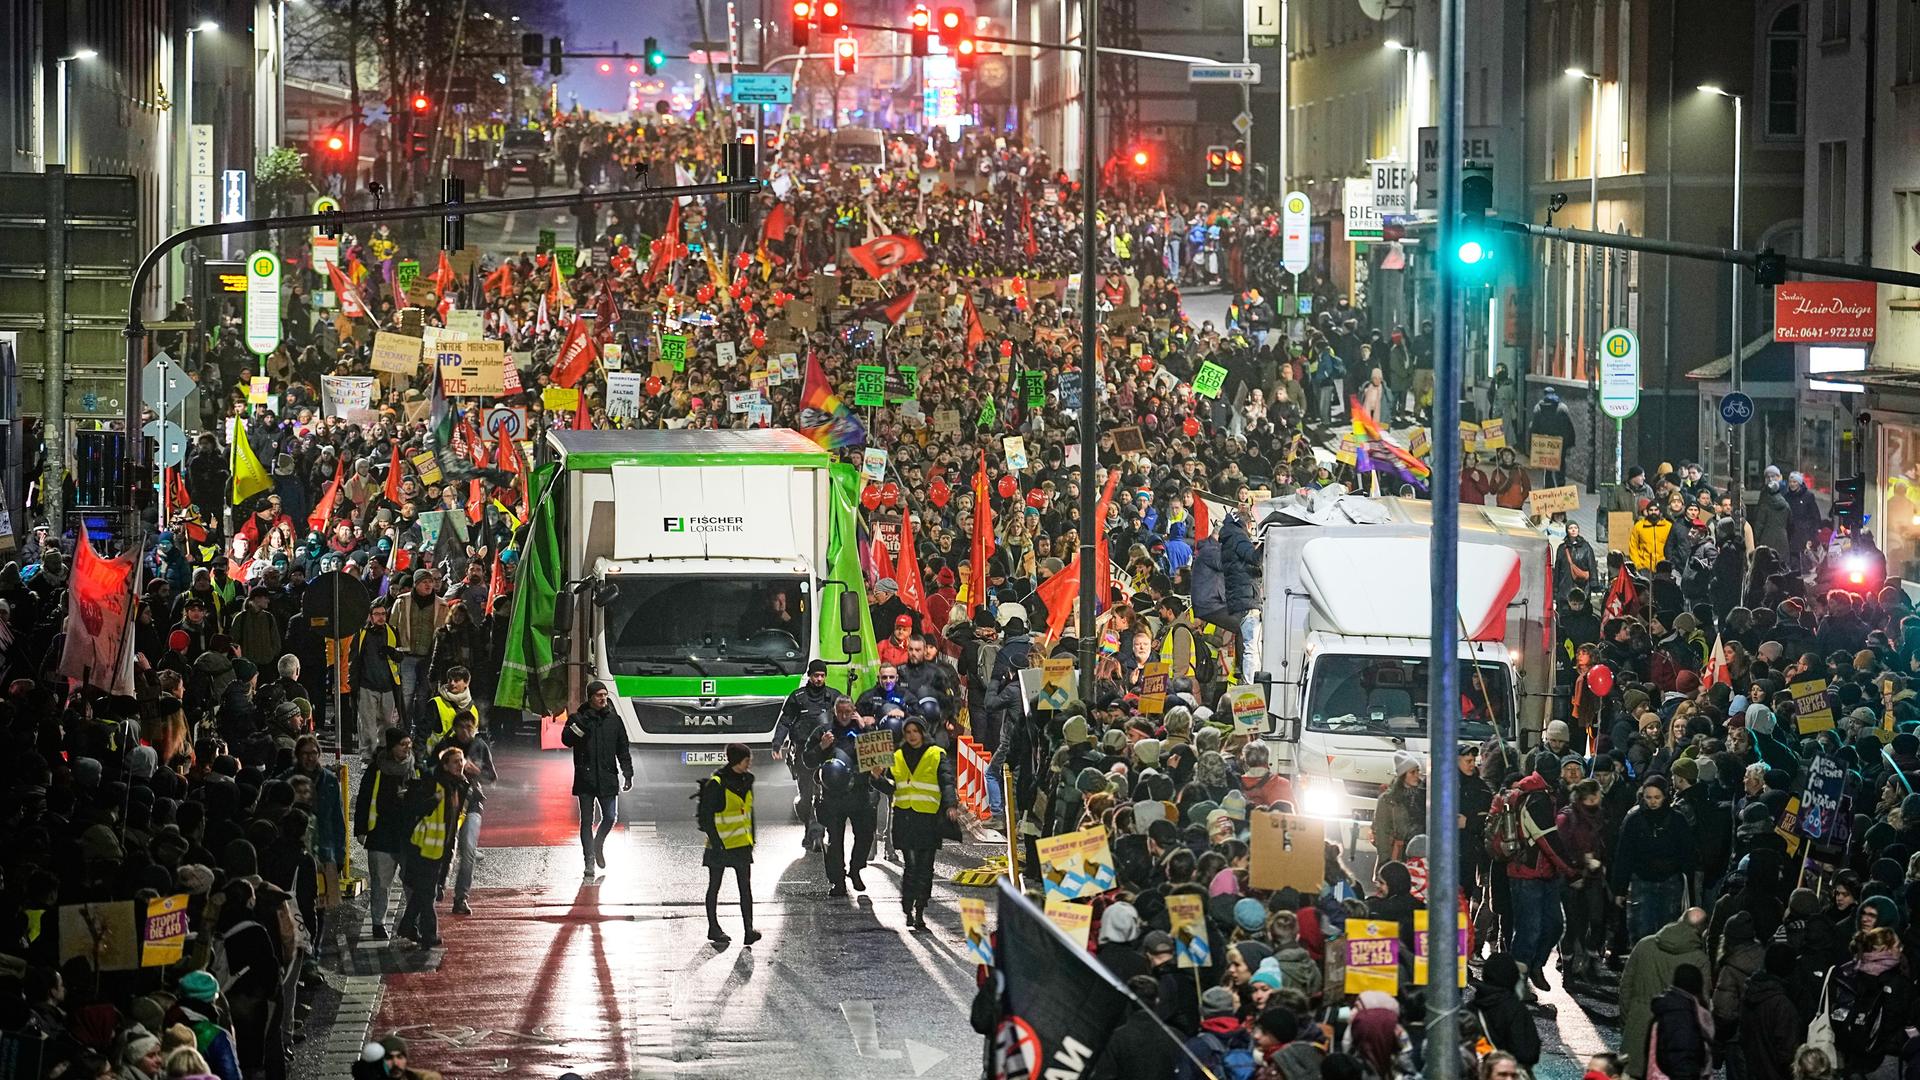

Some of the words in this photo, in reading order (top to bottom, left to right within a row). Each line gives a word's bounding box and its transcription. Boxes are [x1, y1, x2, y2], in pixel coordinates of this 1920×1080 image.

[1777, 327, 1799, 338] Tel.:
[1800, 327, 1823, 338] 0641
[1830, 327, 1847, 338] 972
[1848, 327, 1861, 338] 23
[1862, 327, 1874, 338] 82
[437, 342, 463, 351] EINFACHE
[662, 342, 684, 351] FCK
[662, 350, 684, 360] AFD
[858, 373, 883, 384] FCK
[1201, 367, 1221, 382] FCK
[1197, 375, 1220, 388] AFD
[857, 383, 883, 393] AFD
[690, 516, 743, 524] FISCHER
[690, 525, 744, 533] LOGISTIK
[1797, 692, 1825, 708] STOPPT
[1800, 704, 1812, 715] DIE
[1812, 701, 1827, 713] AFD
[684, 715, 733, 726] MAN
[687, 752, 700, 762] GI
[704, 752, 716, 762] MF
[860, 756, 877, 769] FCK
[150, 911, 181, 928] STOPPT
[150, 927, 165, 940] DIE
[165, 922, 182, 937] AFD
[1350, 939, 1392, 954] STOPPT
[1351, 952, 1370, 966] DIE
[1371, 951, 1393, 965] AFD
